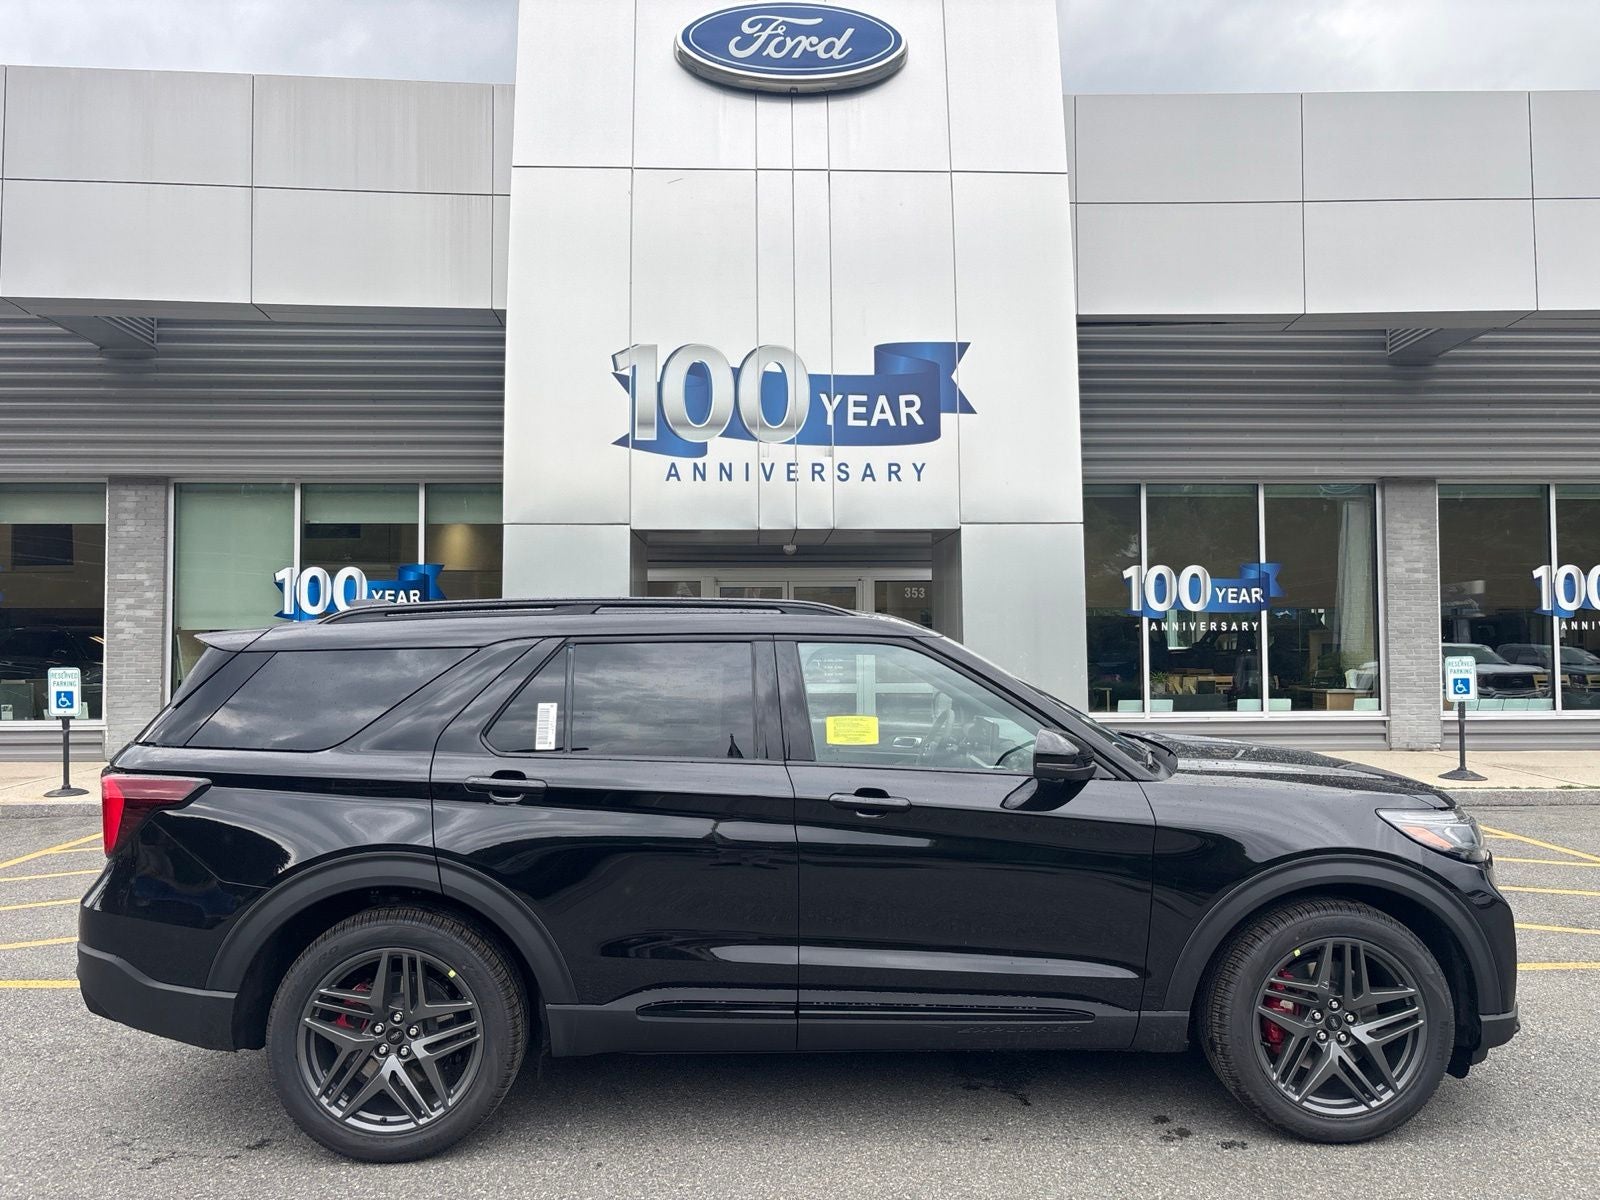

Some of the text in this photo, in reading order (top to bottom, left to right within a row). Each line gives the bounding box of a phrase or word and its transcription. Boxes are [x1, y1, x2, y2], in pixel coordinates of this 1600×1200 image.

[728, 15, 855, 60] Ford
[611, 343, 925, 444] 100 YEAR
[665, 462, 927, 482] ANNIVERSARY
[274, 566, 368, 615] 100
[904, 587, 925, 598] 353
[1122, 565, 1264, 611] 100 YEAR
[1150, 621, 1259, 632] ANNIVERSARY
[1560, 620, 1600, 631] ANNI
